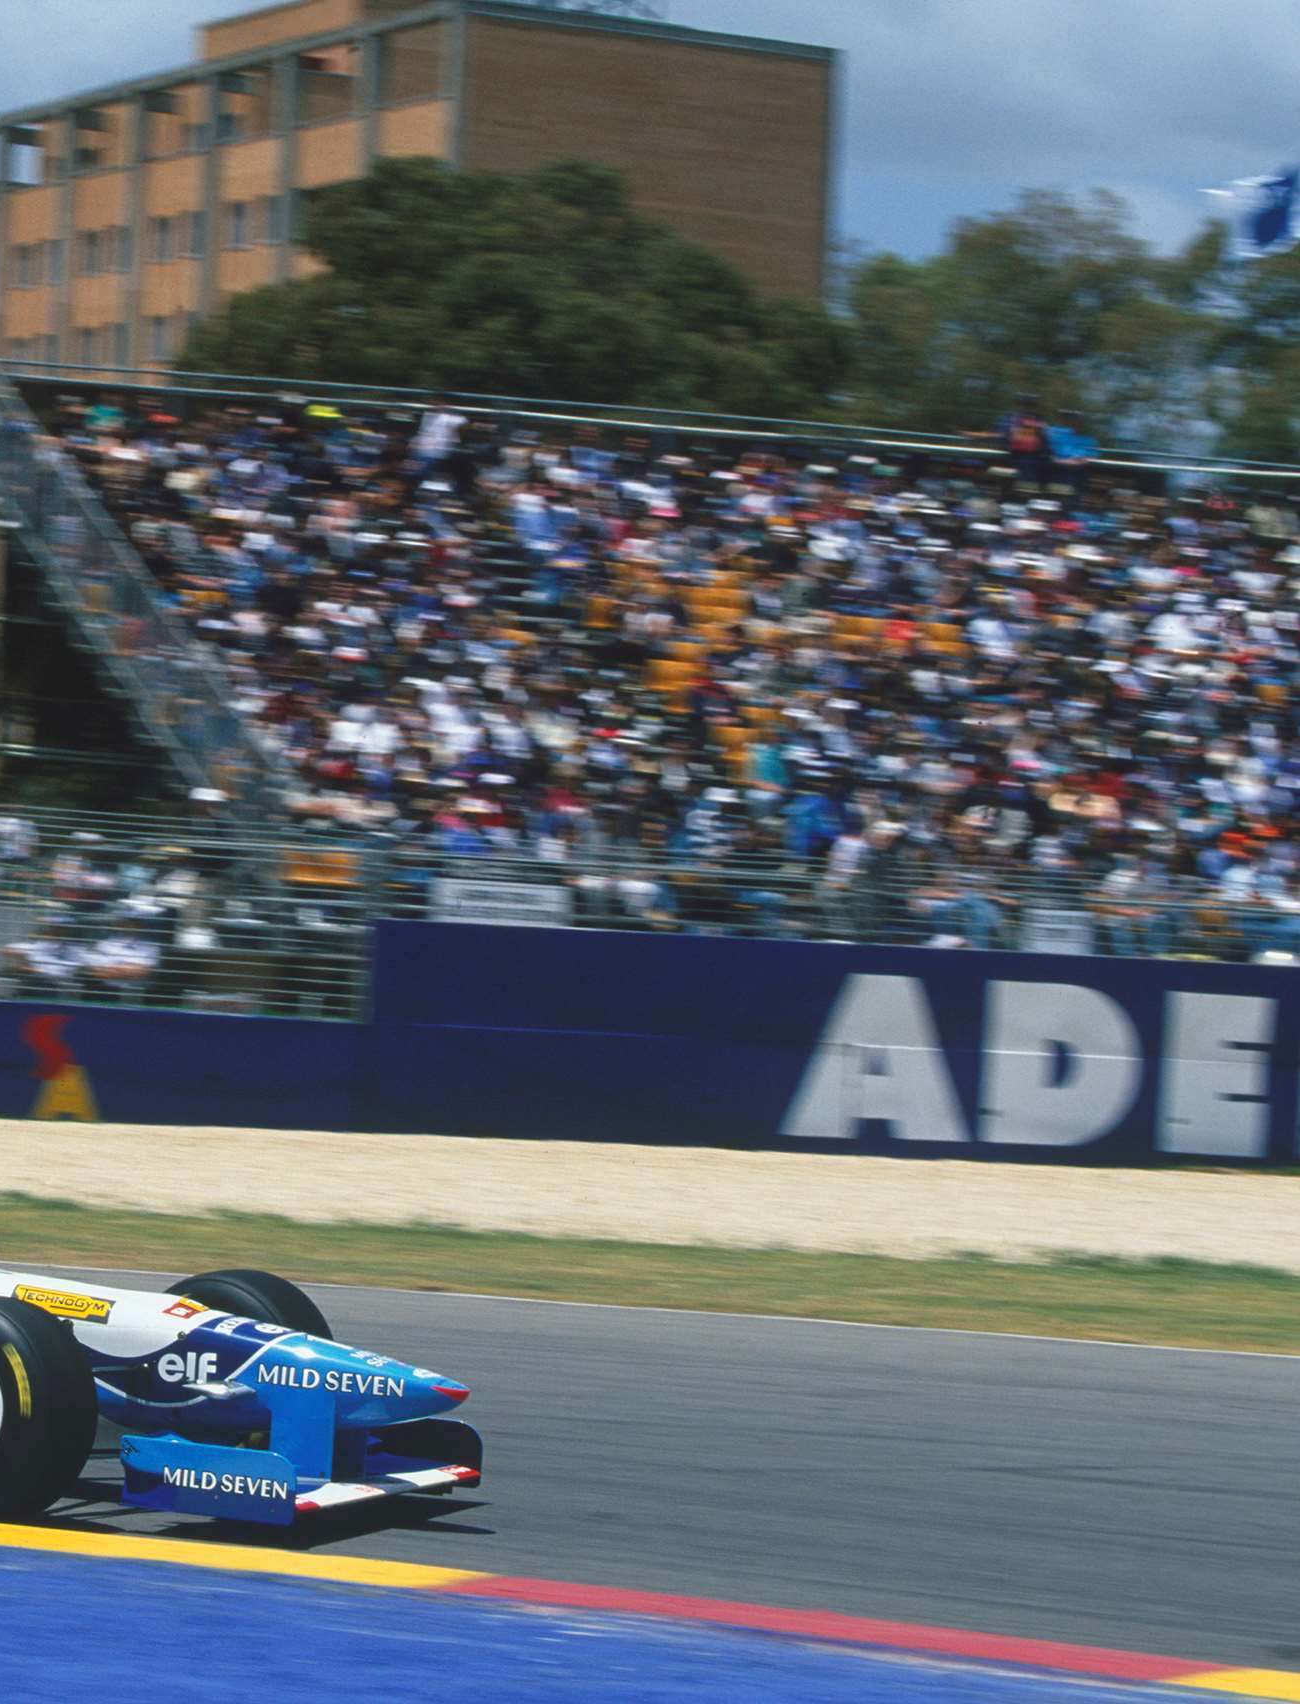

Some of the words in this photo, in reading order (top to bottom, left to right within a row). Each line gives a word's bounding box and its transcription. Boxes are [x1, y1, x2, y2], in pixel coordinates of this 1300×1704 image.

[777, 972, 1300, 1158] ADE
[157, 1352, 217, 1383] elf
[257, 1363, 320, 1389] MILD
[325, 1371, 405, 1399] SEVEN
[163, 1467, 217, 1491] MILD
[221, 1475, 288, 1501] SEVEN
